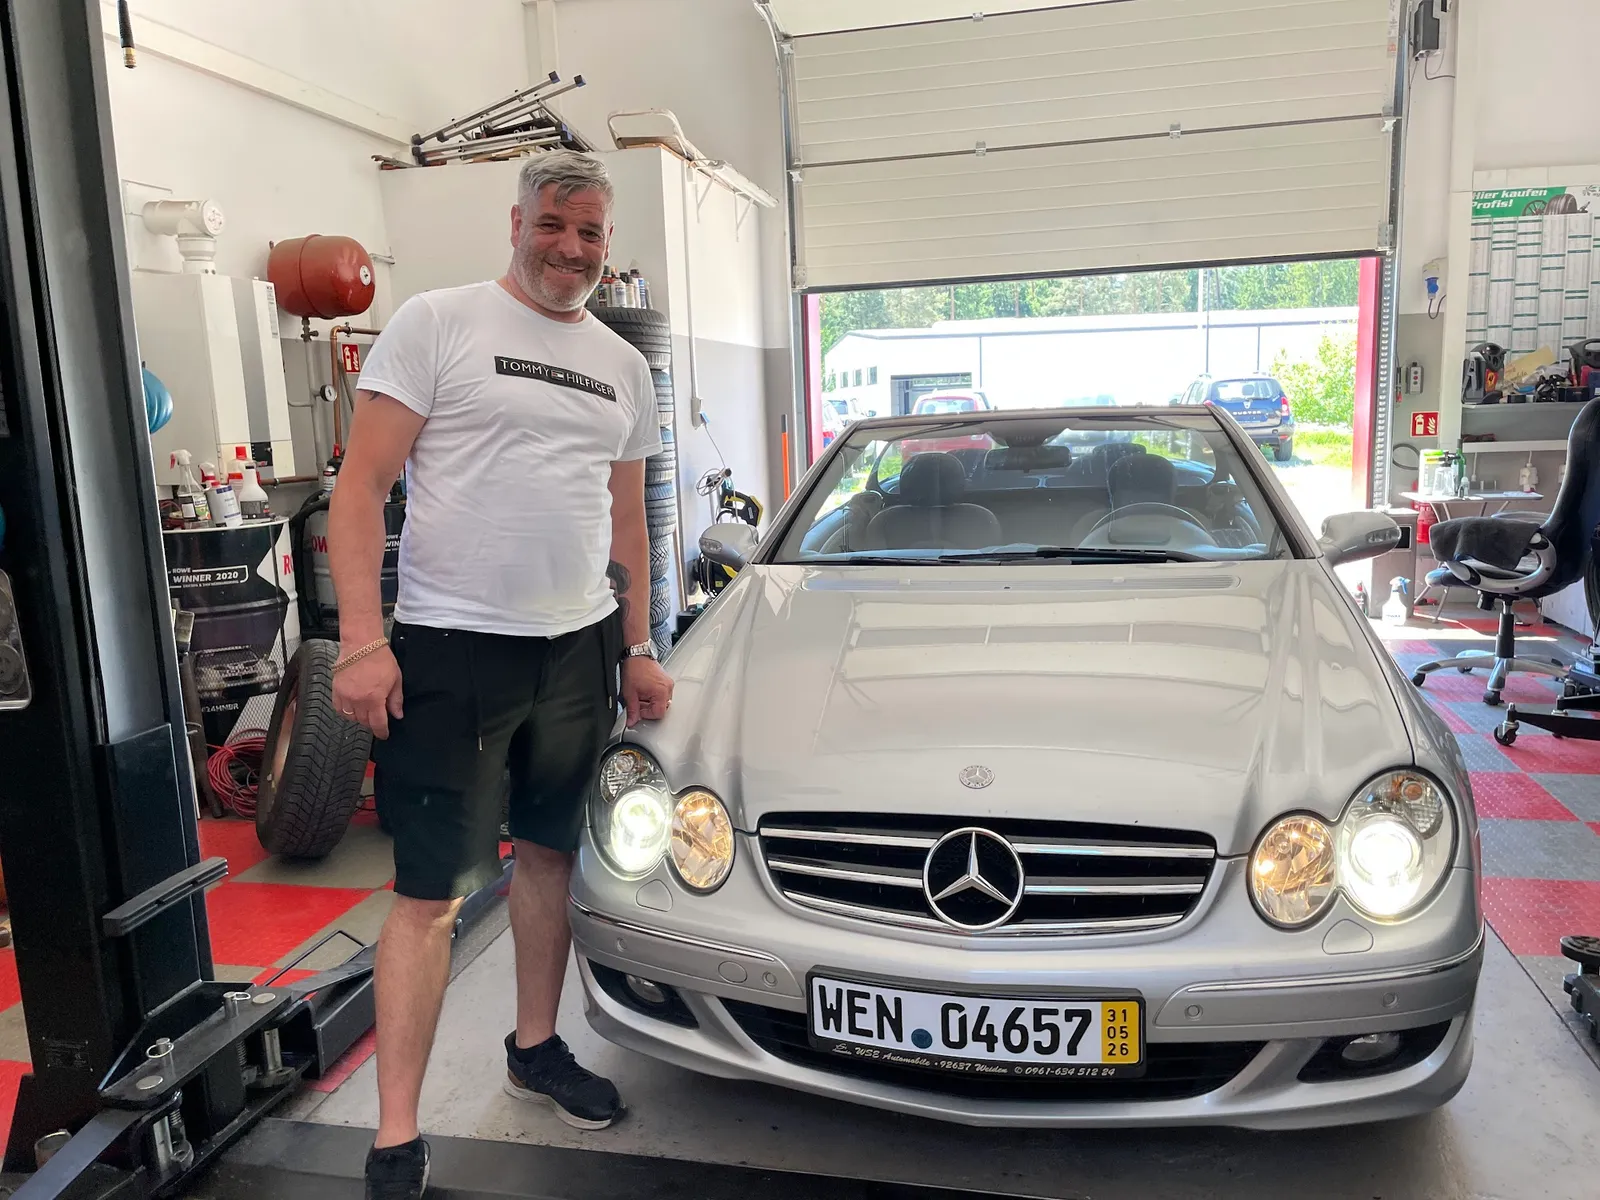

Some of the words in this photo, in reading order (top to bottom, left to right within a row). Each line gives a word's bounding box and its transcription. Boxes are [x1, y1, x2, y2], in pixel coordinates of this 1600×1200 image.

[1501, 188, 1547, 198] kaufen
[500, 359, 549, 377] TOMMY
[566, 373, 614, 396] HILFIGER
[173, 573, 212, 583] WINNER
[216, 571, 239, 580] 2020
[818, 984, 904, 1043] WEN
[941, 1002, 1092, 1057] 04657
[1107, 1009, 1128, 1022] 31
[1107, 1026, 1129, 1039] 05
[1107, 1043, 1129, 1056] 26
[855, 1046, 880, 1059] WSE
[882, 1051, 931, 1067] Automobile
[939, 1060, 972, 1071] 92637
[974, 1063, 1009, 1074] Weiden
[1025, 1066, 1075, 1076] 0961-634
[1077, 1067, 1099, 1076] 512
[1101, 1067, 1116, 1076] 24
